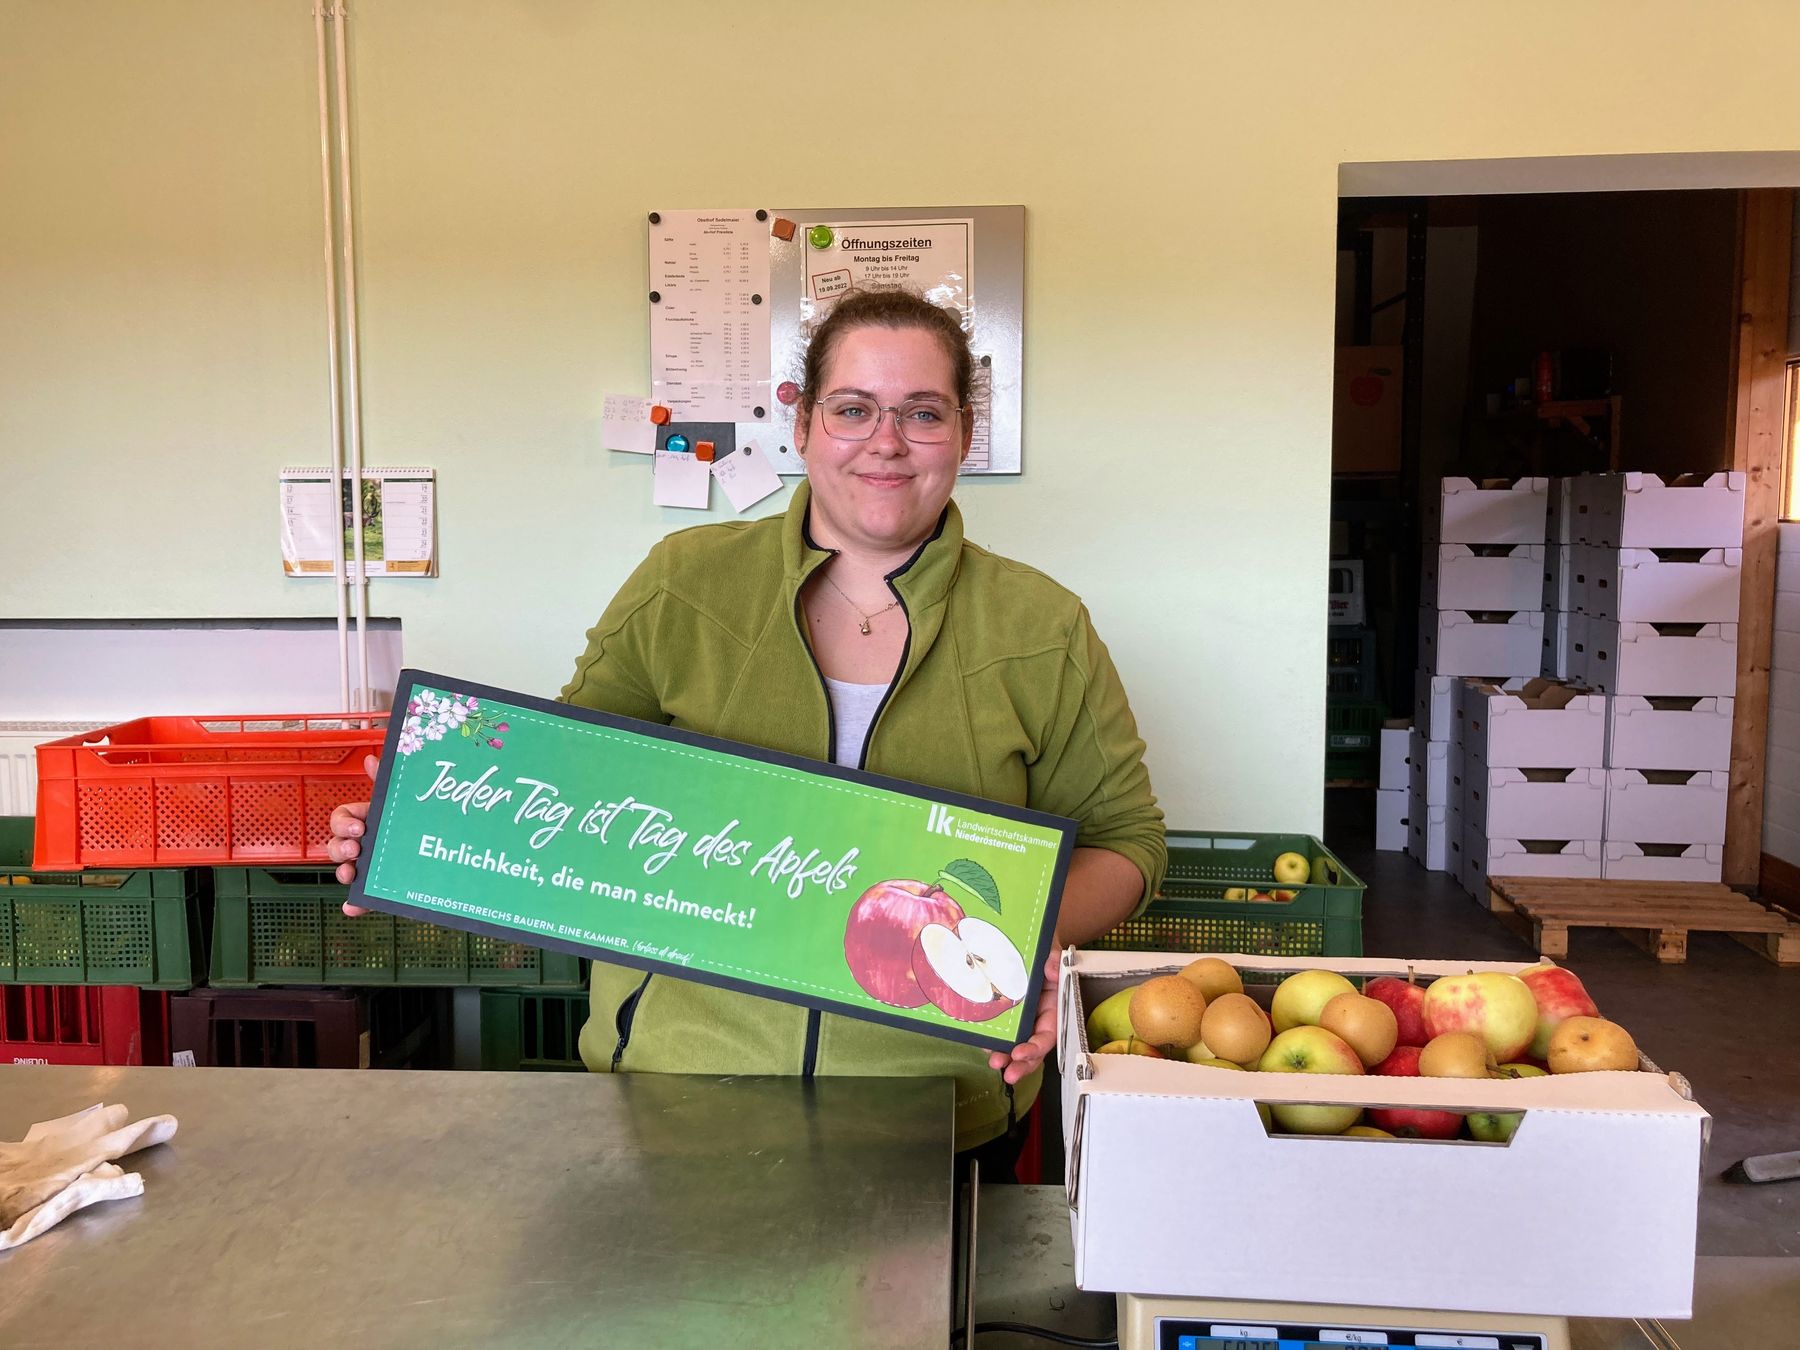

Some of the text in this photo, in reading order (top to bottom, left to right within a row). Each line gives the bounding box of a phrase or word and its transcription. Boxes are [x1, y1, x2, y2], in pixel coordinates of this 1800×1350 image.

[841, 237, 932, 250] Öffnungszeiten
[853, 255, 881, 264] Montag
[894, 254, 920, 263] Freitag
[821, 276, 833, 284] Neu
[415, 760, 860, 899] Jeder Tag ist Tag des Apfels
[926, 803, 955, 837] lk
[955, 829, 1027, 854] Niederösterreich
[957, 819, 1058, 849] Landwirtschaftskammer
[418, 834, 756, 929] Ehrlichkeit, die man schmeckt!
[406, 890, 512, 922] NIEDERÖSTERREICHS
[513, 914, 556, 932] BAUERN.
[558, 924, 582, 938] EINE
[583, 930, 630, 948] KAMMER.
[1239, 1328, 1249, 1338] kg
[1345, 1333, 1362, 1343] €/kg
